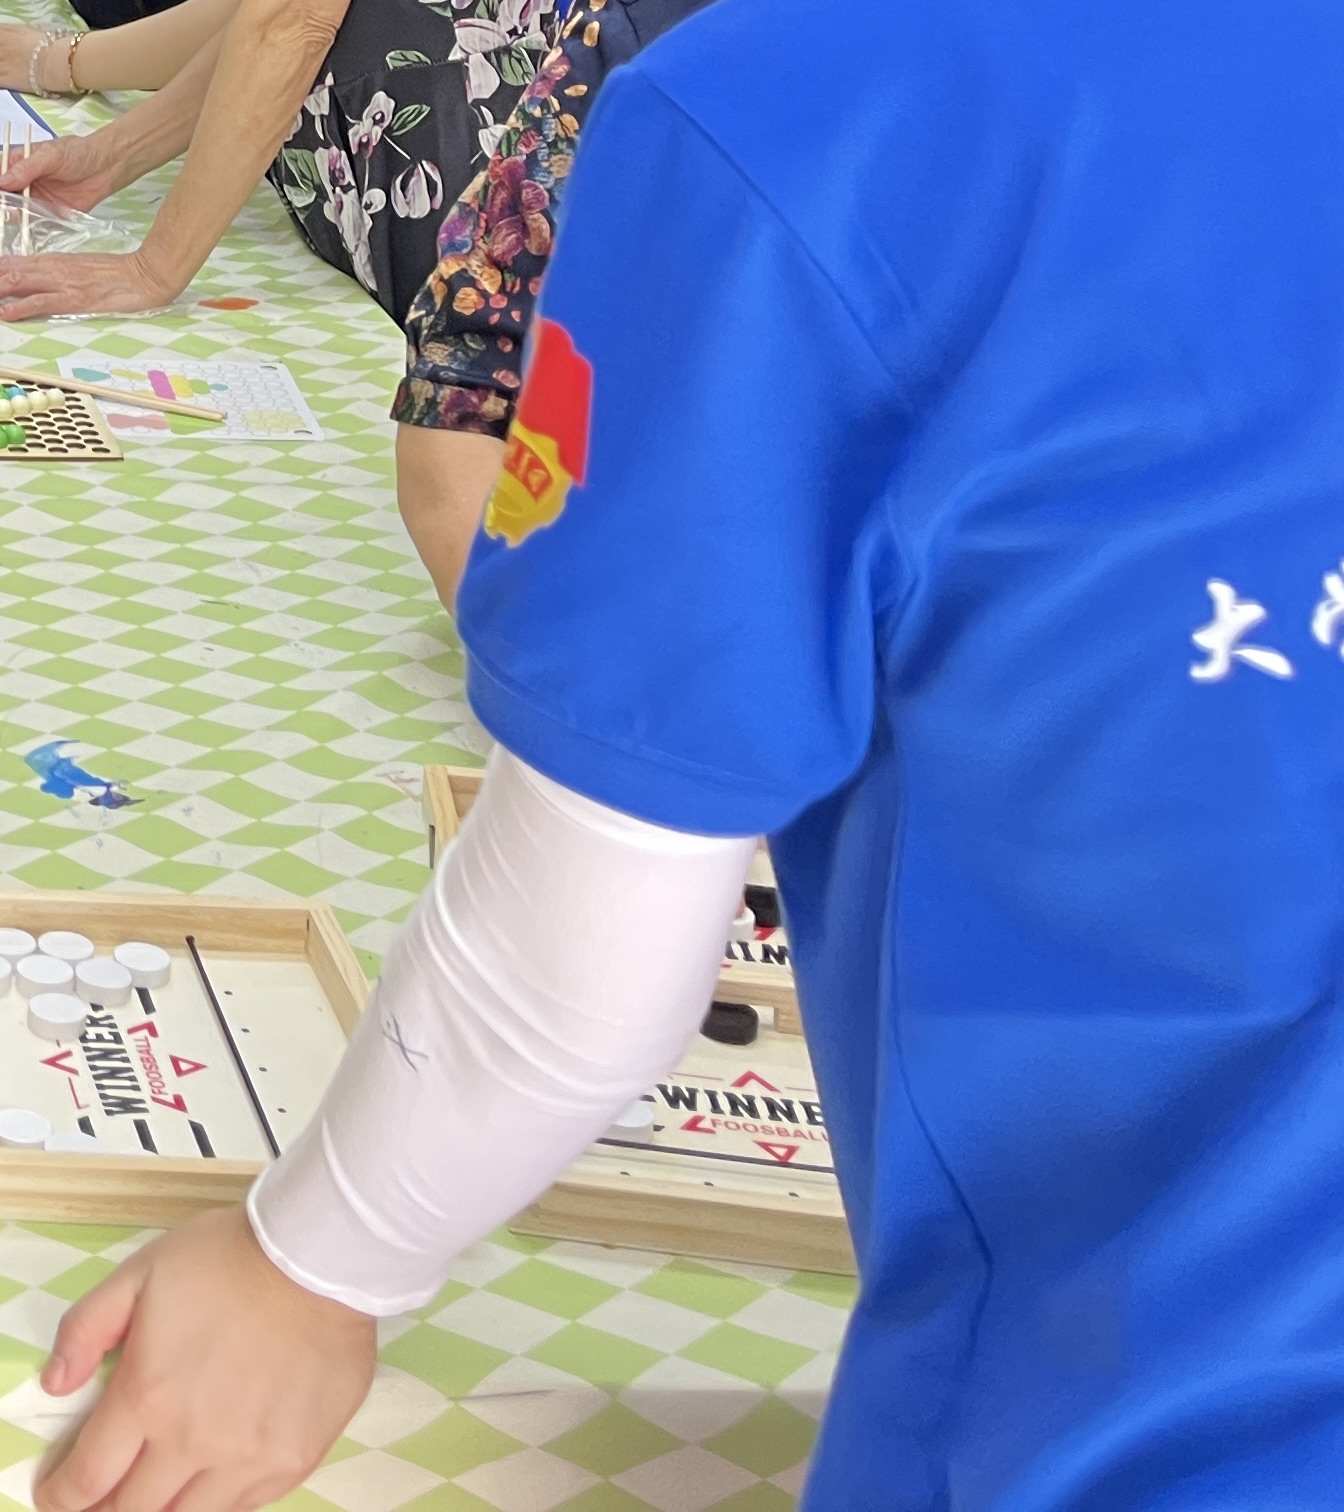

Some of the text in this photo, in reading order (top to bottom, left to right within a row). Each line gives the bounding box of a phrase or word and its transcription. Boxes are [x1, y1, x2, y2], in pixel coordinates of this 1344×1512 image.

[79, 1014, 150, 1117] WINNER
[133, 1036, 168, 1096] FOOSBALL
[657, 1083, 824, 1126] WINNE
